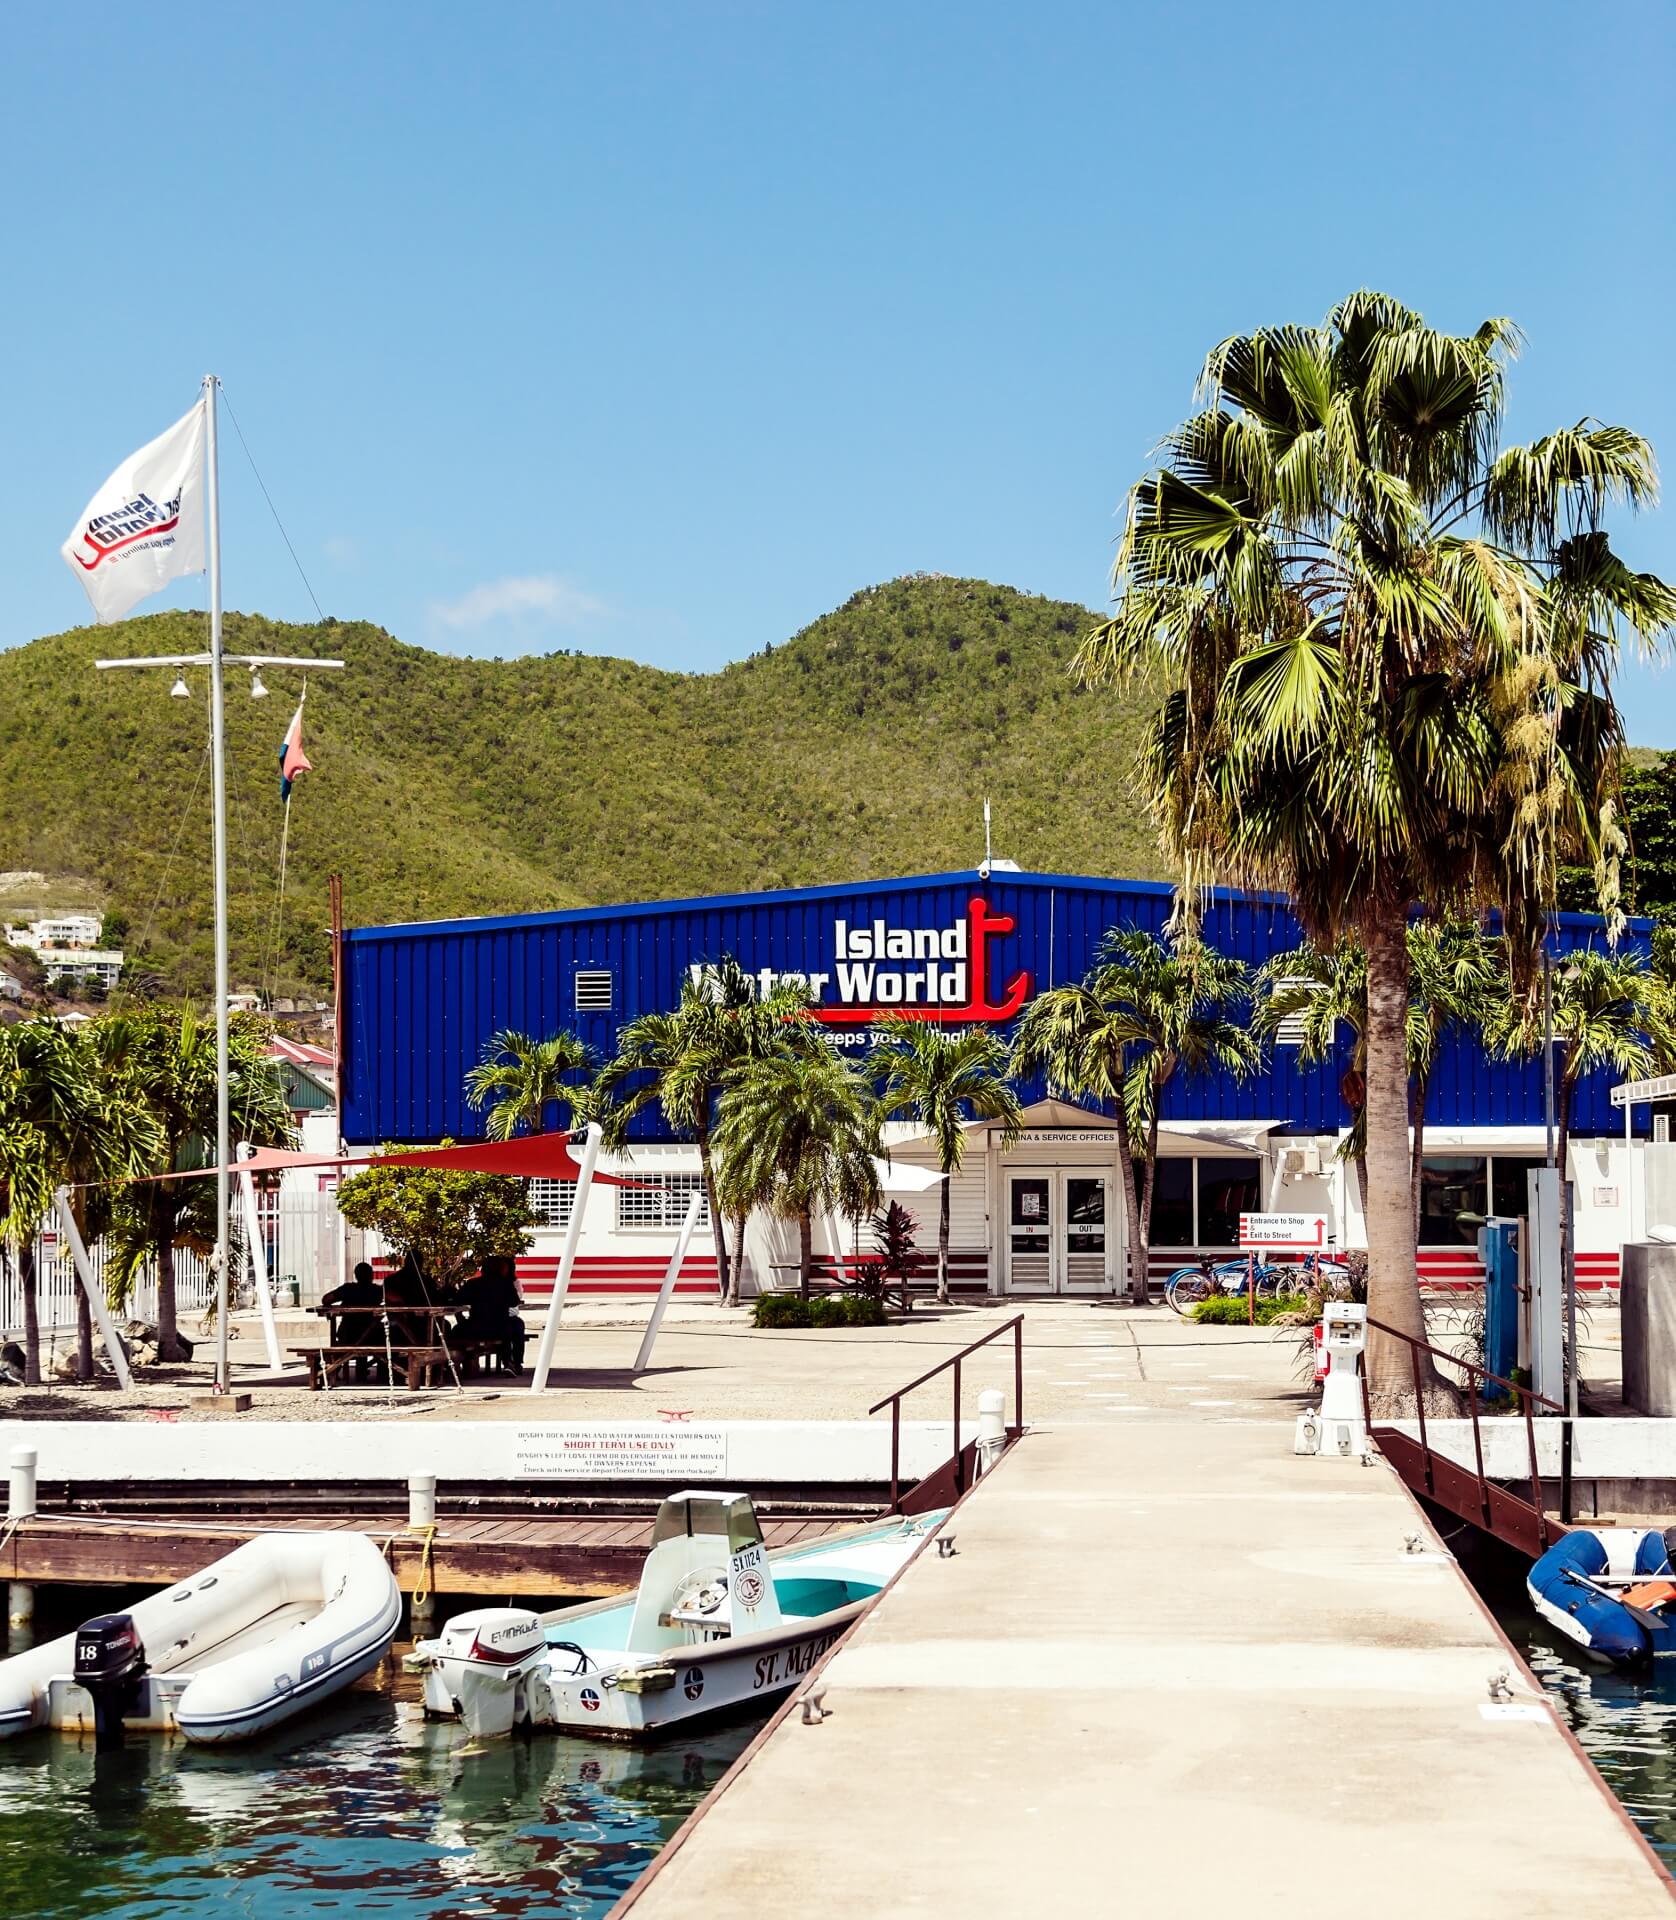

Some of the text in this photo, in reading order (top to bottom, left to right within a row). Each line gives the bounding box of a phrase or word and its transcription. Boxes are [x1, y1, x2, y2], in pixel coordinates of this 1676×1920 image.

[835, 919, 967, 959] Island
[835, 962, 967, 1003] World
[1288, 1217, 1305, 1226] Shop
[1079, 1225, 1093, 1233] OUT
[1250, 1231, 1263, 1239] Exit
[1272, 1231, 1292, 1239] Street
[564, 1441, 676, 1449] SHORT TERM USE ONLY
[591, 1466, 635, 1475] department
[79, 1645, 98, 1661] 18
[753, 1652, 780, 1690] ST.
